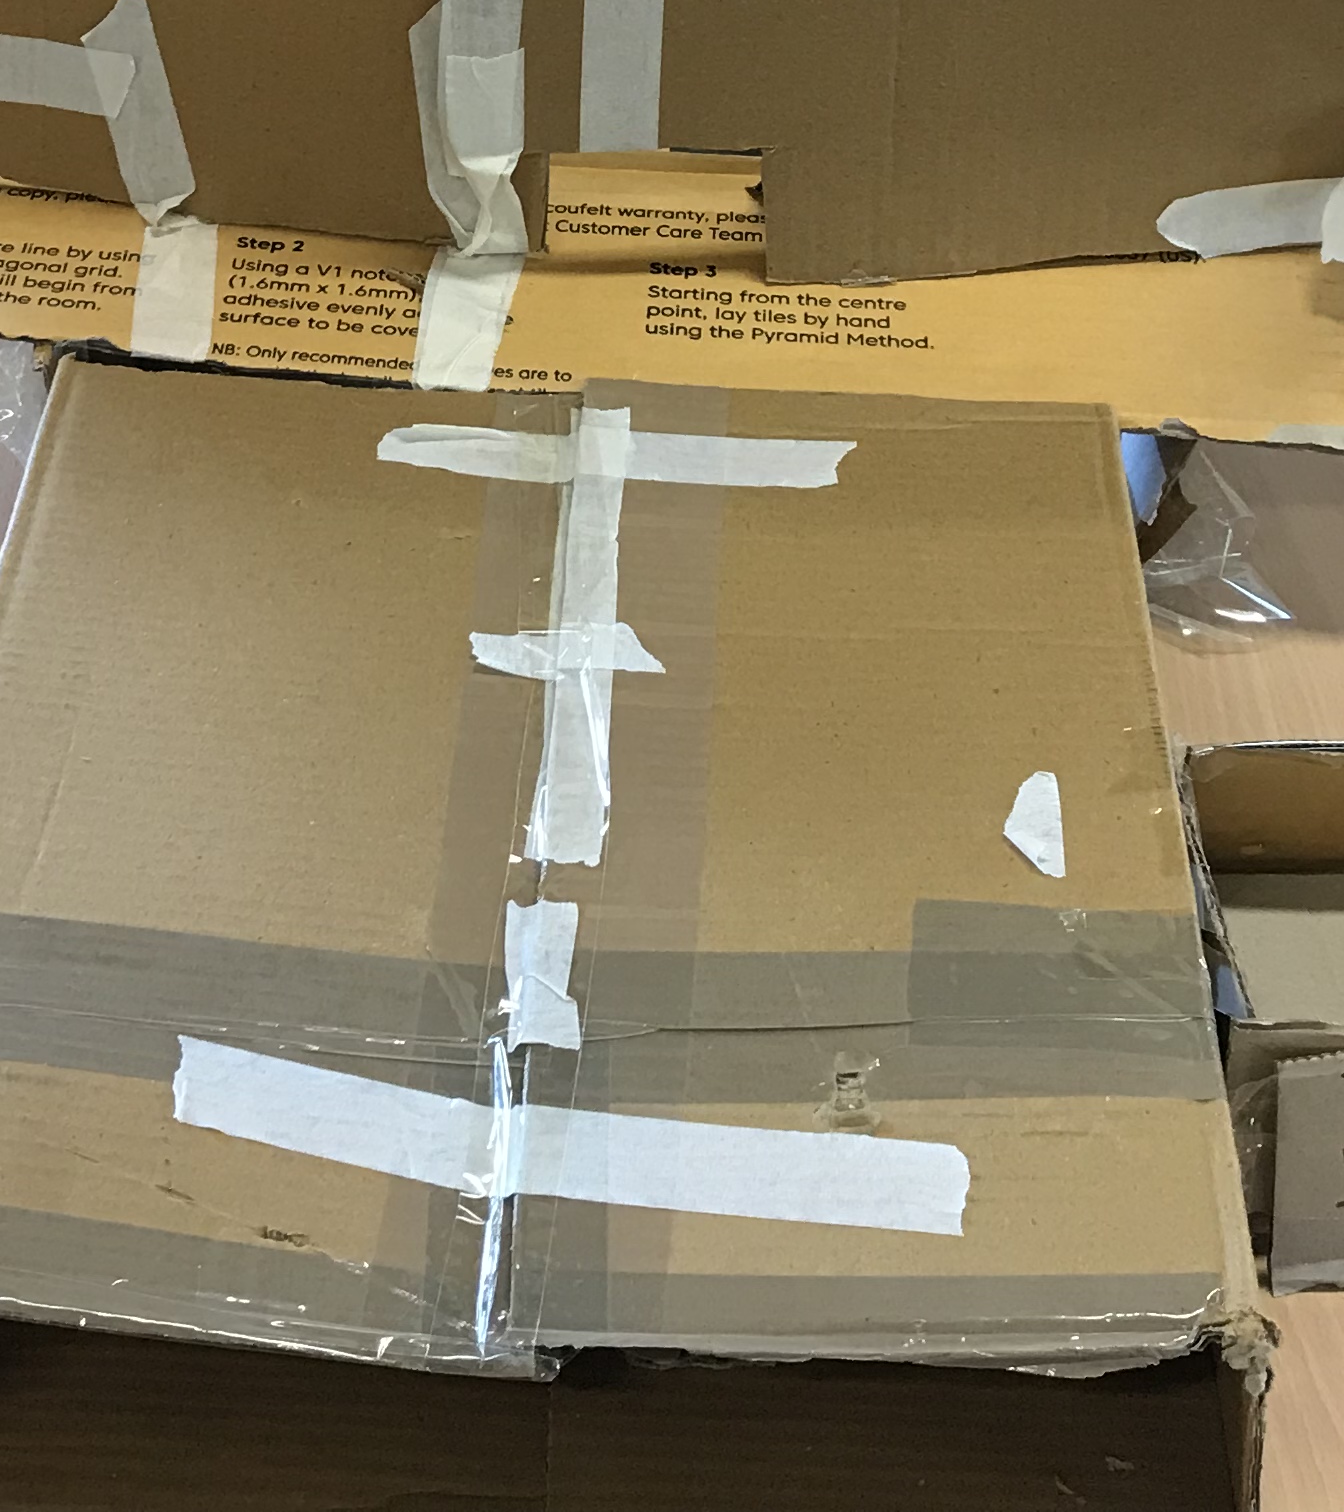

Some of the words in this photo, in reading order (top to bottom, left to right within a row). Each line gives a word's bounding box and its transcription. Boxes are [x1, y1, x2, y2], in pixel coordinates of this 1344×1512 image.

[548, 202, 613, 217] coufelt
[617, 204, 709, 224] warranty,
[716, 210, 766, 225] pleas
[555, 219, 650, 238] Customer
[656, 224, 703, 240] Care
[708, 226, 763, 242] Team
[21, 242, 60, 257] line
[66, 246, 94, 263] by
[236, 236, 286, 252] Step
[291, 239, 305, 252] 2
[73, 264, 124, 280] grid.
[231, 257, 289, 277] Using
[295, 264, 310, 276] a
[316, 264, 342, 278] V1
[649, 262, 699, 278] Step
[704, 264, 718, 279] 3
[22, 276, 86, 293] begin
[93, 281, 143, 297] from
[228, 276, 311, 294] (1.6mm
[316, 283, 329, 294] x
[37, 296, 102, 312] room.
[222, 293, 321, 313] adhesive
[326, 301, 397, 321] evenly
[648, 284, 733, 305] Starting
[738, 290, 790, 307] from
[796, 293, 832, 308] the
[838, 296, 907, 312] centre
[218, 310, 301, 328] surface
[307, 317, 330, 331] to
[336, 318, 365, 334] be
[646, 303, 708, 322] point,
[715, 306, 747, 325] lay
[753, 309, 797, 325] tiles
[803, 311, 830, 329] by
[835, 313, 892, 330] hand
[645, 322, 703, 341] using
[709, 324, 745, 340] the
[751, 328, 840, 347] Pyramid
[845, 332, 935, 350] Method.
[211, 342, 242, 356] NB:
[246, 345, 287, 362] Only
[519, 370, 549, 382] are
[553, 371, 573, 383] to
